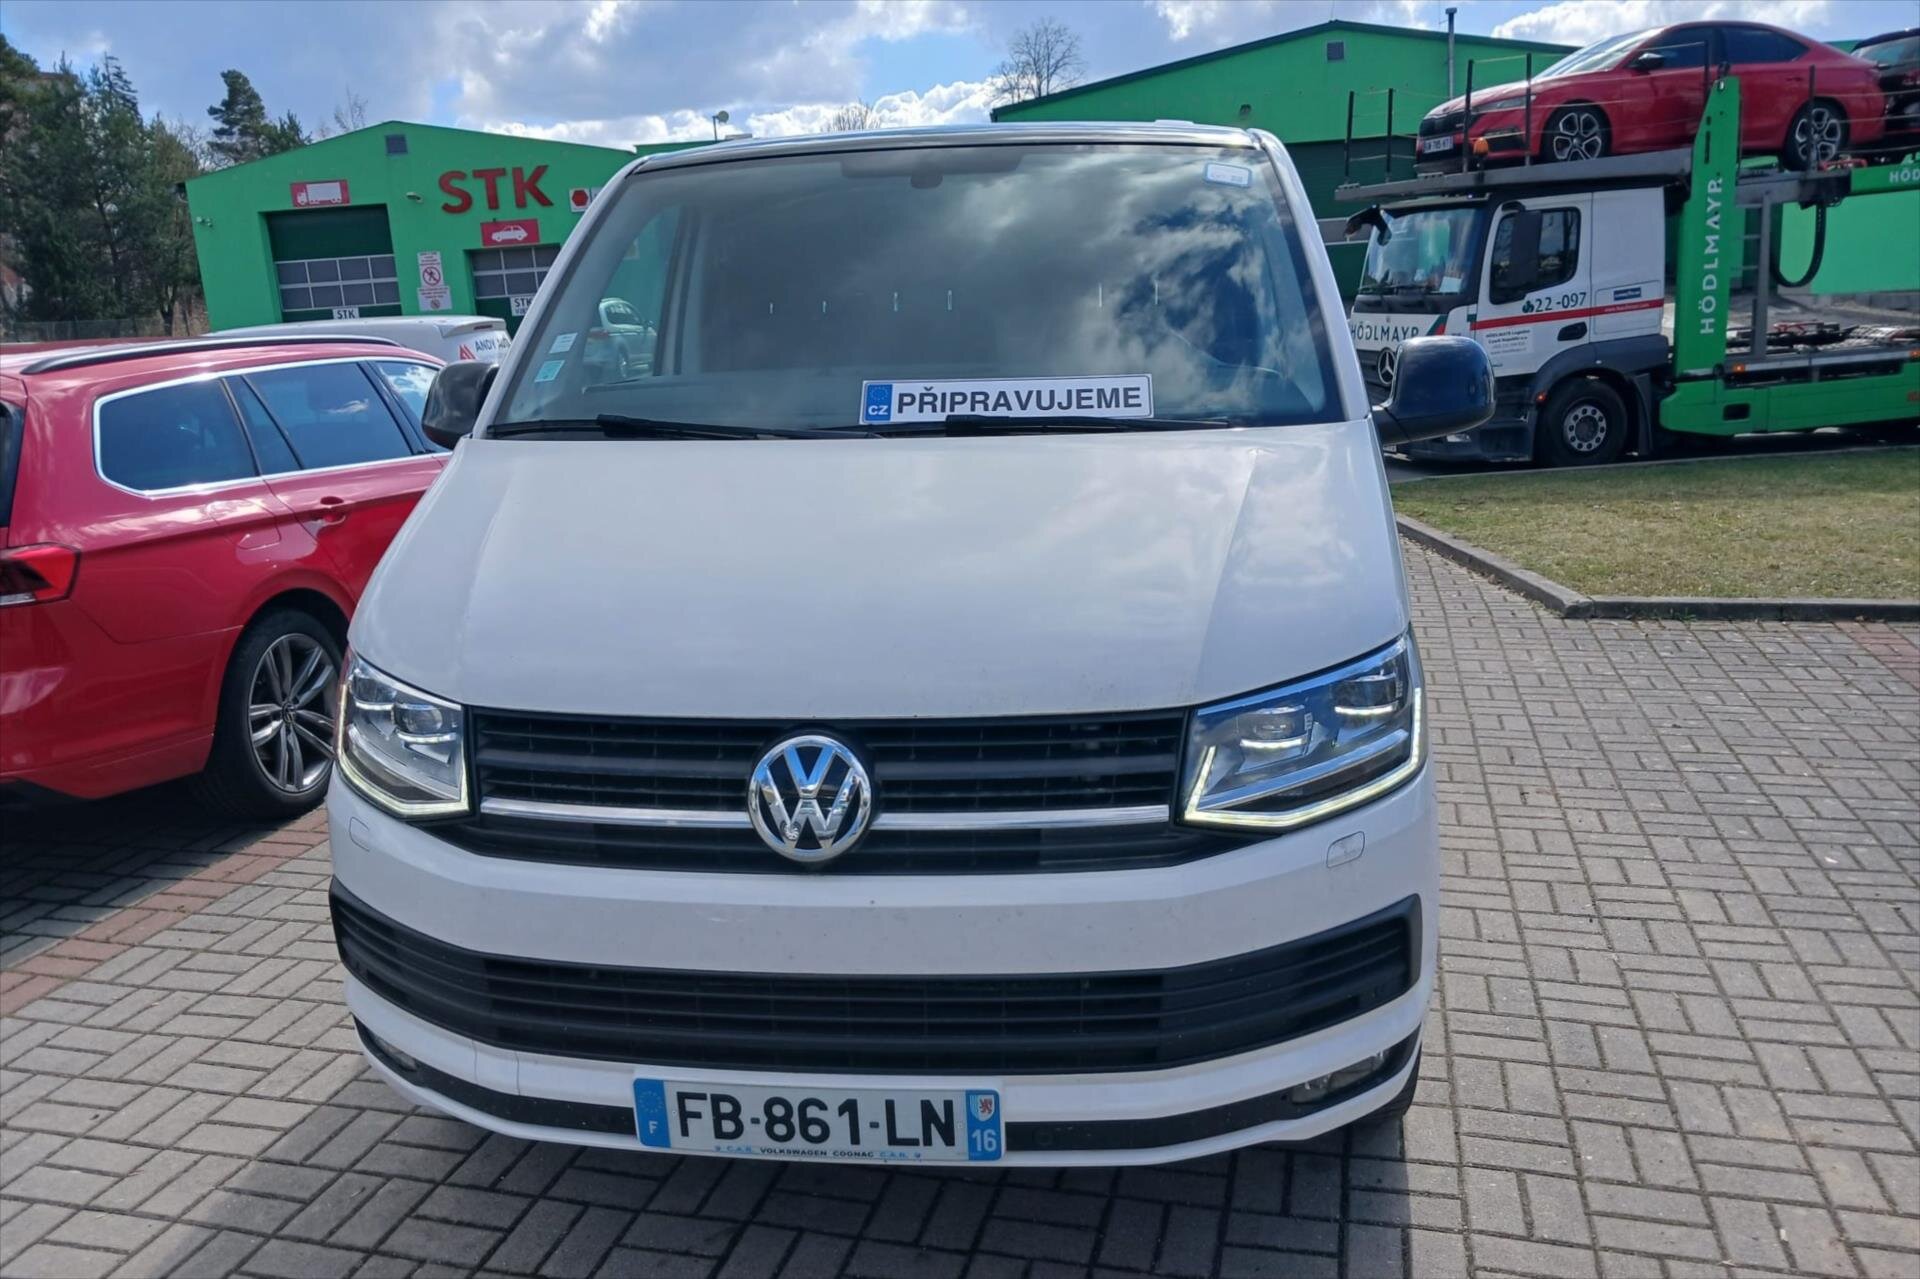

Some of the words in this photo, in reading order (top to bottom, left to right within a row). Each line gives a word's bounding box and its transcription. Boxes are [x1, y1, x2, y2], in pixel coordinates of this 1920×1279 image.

[438, 165, 554, 214] STK
[1698, 178, 1723, 335] HÖDLMAYR
[337, 309, 356, 319] STK
[475, 339, 496, 352] ANDY
[897, 386, 1142, 414] PŘIPRAVUJEME
[868, 405, 889, 415] CZ
[648, 1121, 658, 1134] F
[971, 1128, 997, 1152] 16
[760, 1146, 827, 1157] VOLKSWAGEN
